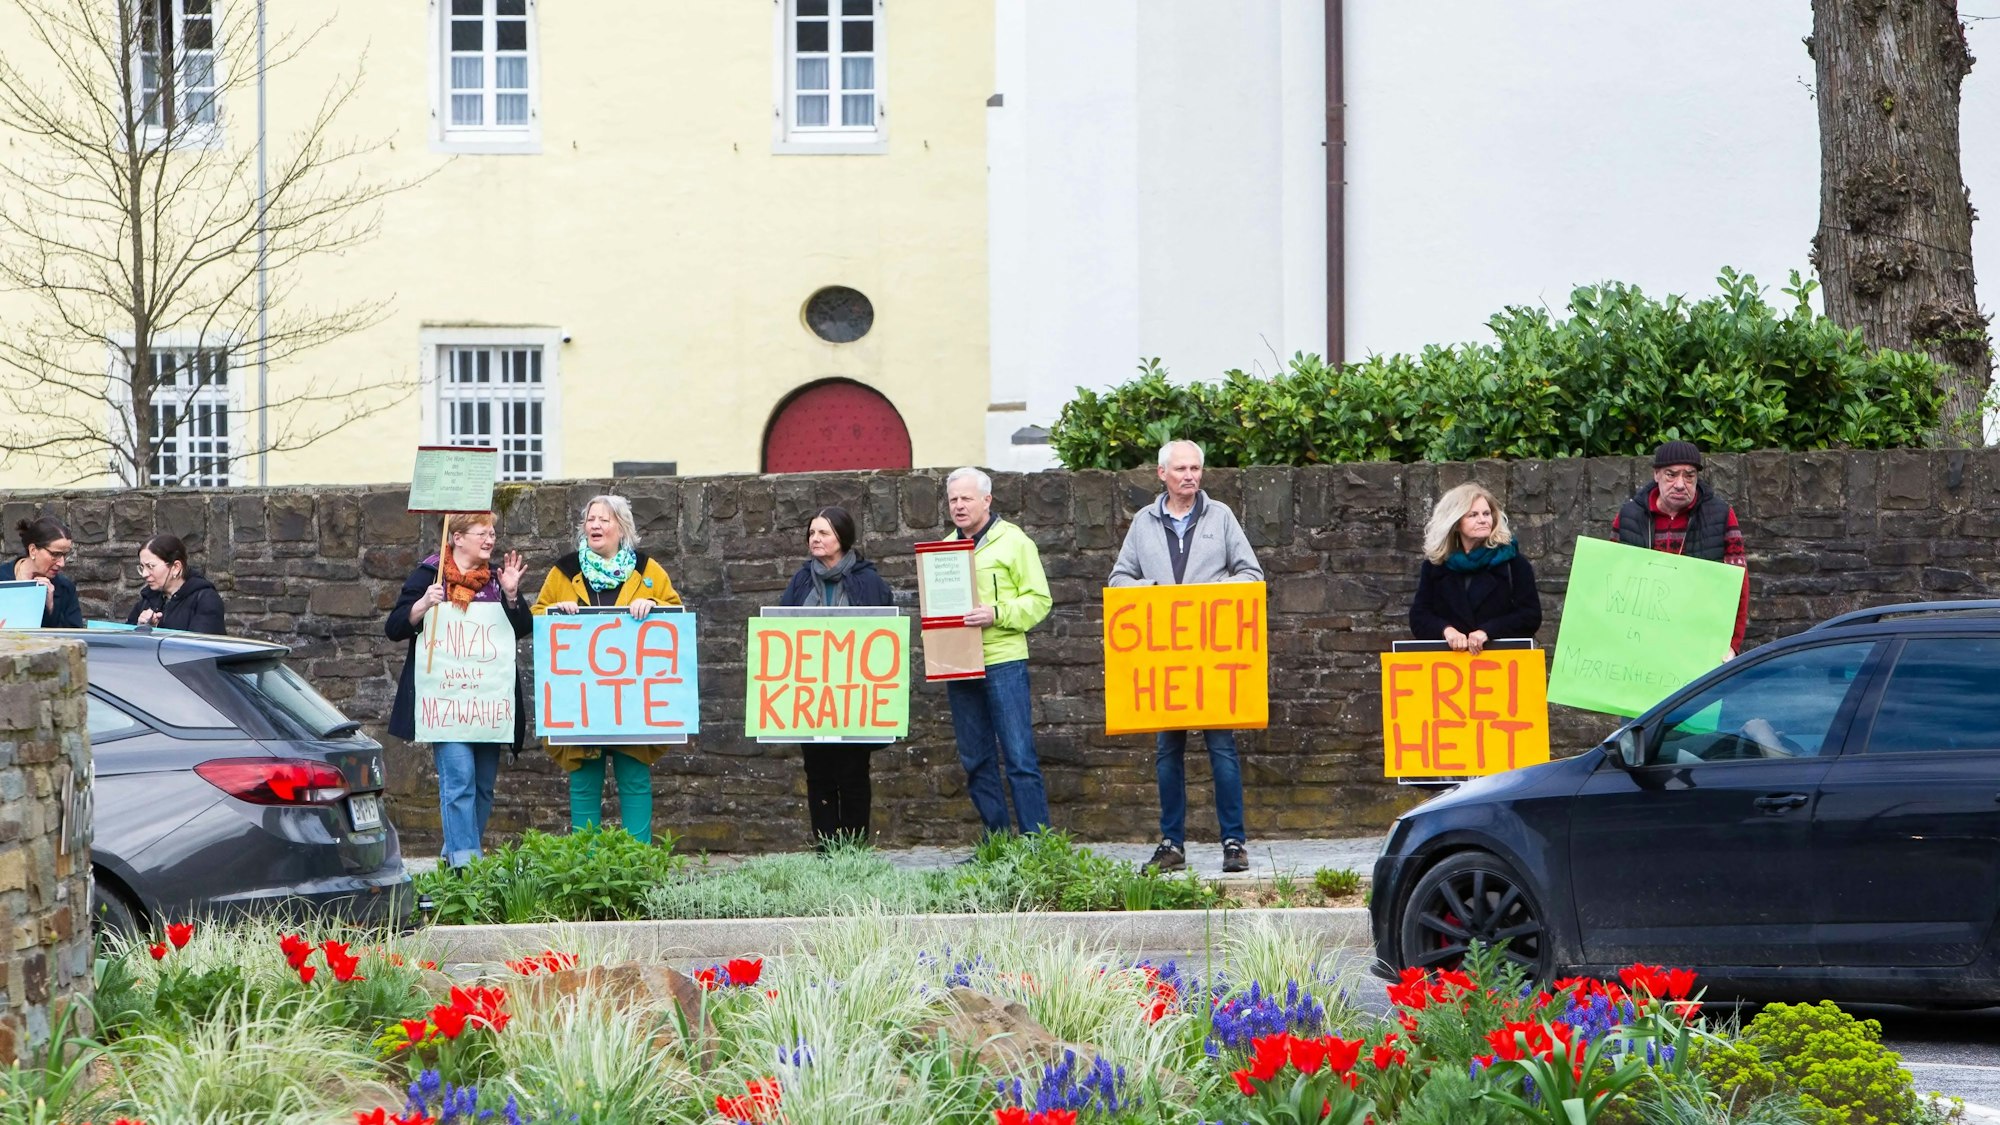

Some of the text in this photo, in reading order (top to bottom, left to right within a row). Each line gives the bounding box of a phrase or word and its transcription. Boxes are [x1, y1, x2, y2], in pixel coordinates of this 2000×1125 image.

[1605, 573, 1671, 622] WIR
[446, 620, 497, 663] NAZIS
[550, 617, 679, 676] EGA
[1108, 598, 1259, 652] GLEICH
[1626, 627, 1641, 643] in
[753, 629, 901, 683] DEMO
[439, 682, 455, 690] ist
[544, 669, 685, 729] LITÉ
[759, 683, 900, 730] KRATIE
[1133, 663, 1252, 715] HEIT
[1389, 659, 1519, 720] FREI
[422, 696, 513, 729] NAZIWÄHLER
[1393, 719, 1534, 770] HEIT
